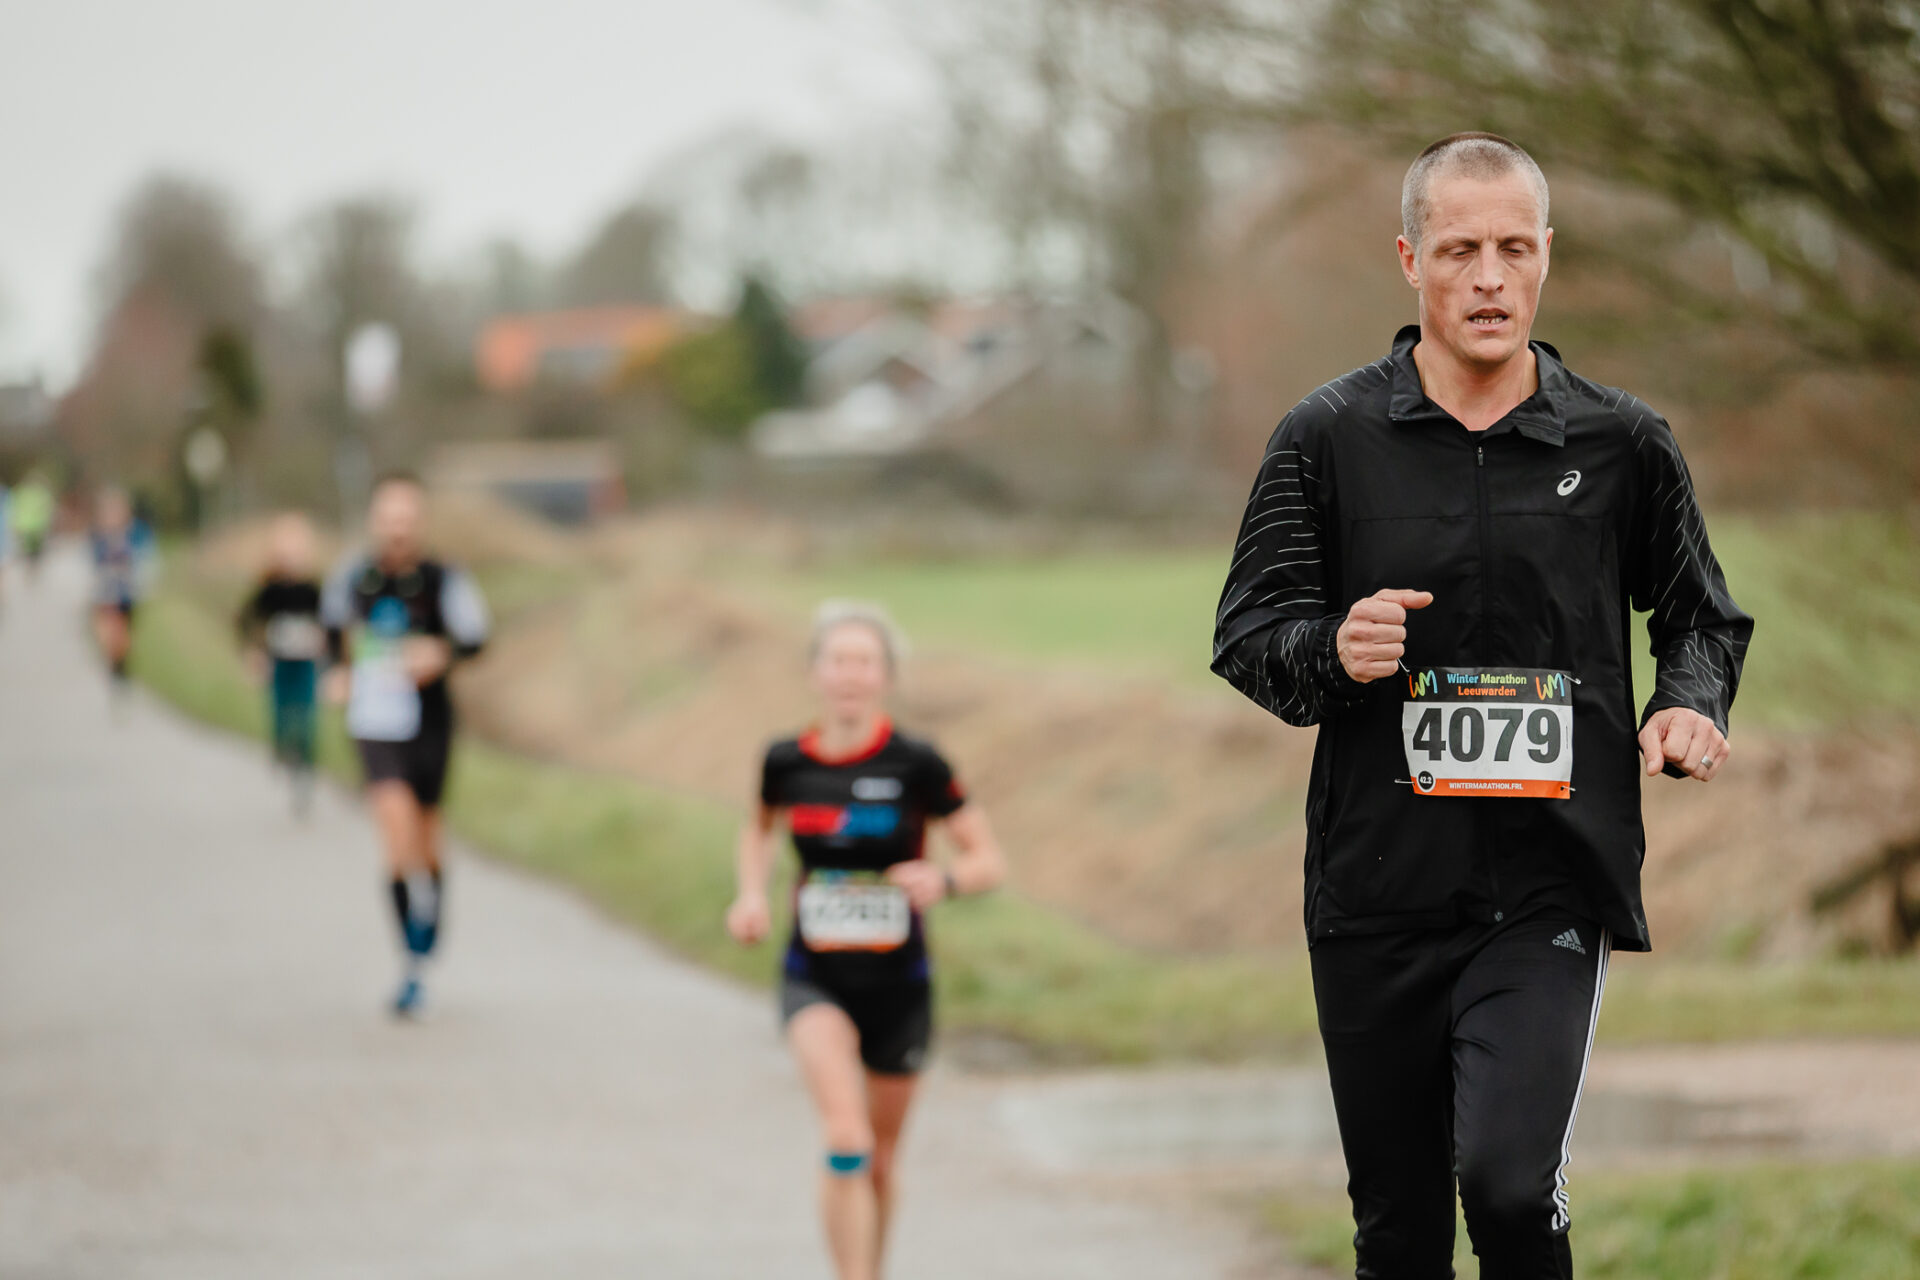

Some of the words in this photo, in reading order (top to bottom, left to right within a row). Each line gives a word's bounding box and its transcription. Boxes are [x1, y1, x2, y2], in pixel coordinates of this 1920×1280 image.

[1447, 673, 1479, 684] Winter
[1480, 673, 1527, 685] Marathon
[1458, 686, 1516, 696] Leeuwarden
[1413, 707, 1561, 763] 4079
[1419, 776, 1432, 784] 42.2
[1449, 782, 1524, 790] WINTERMARATHON.FRL
[1552, 938, 1586, 955] adidas
